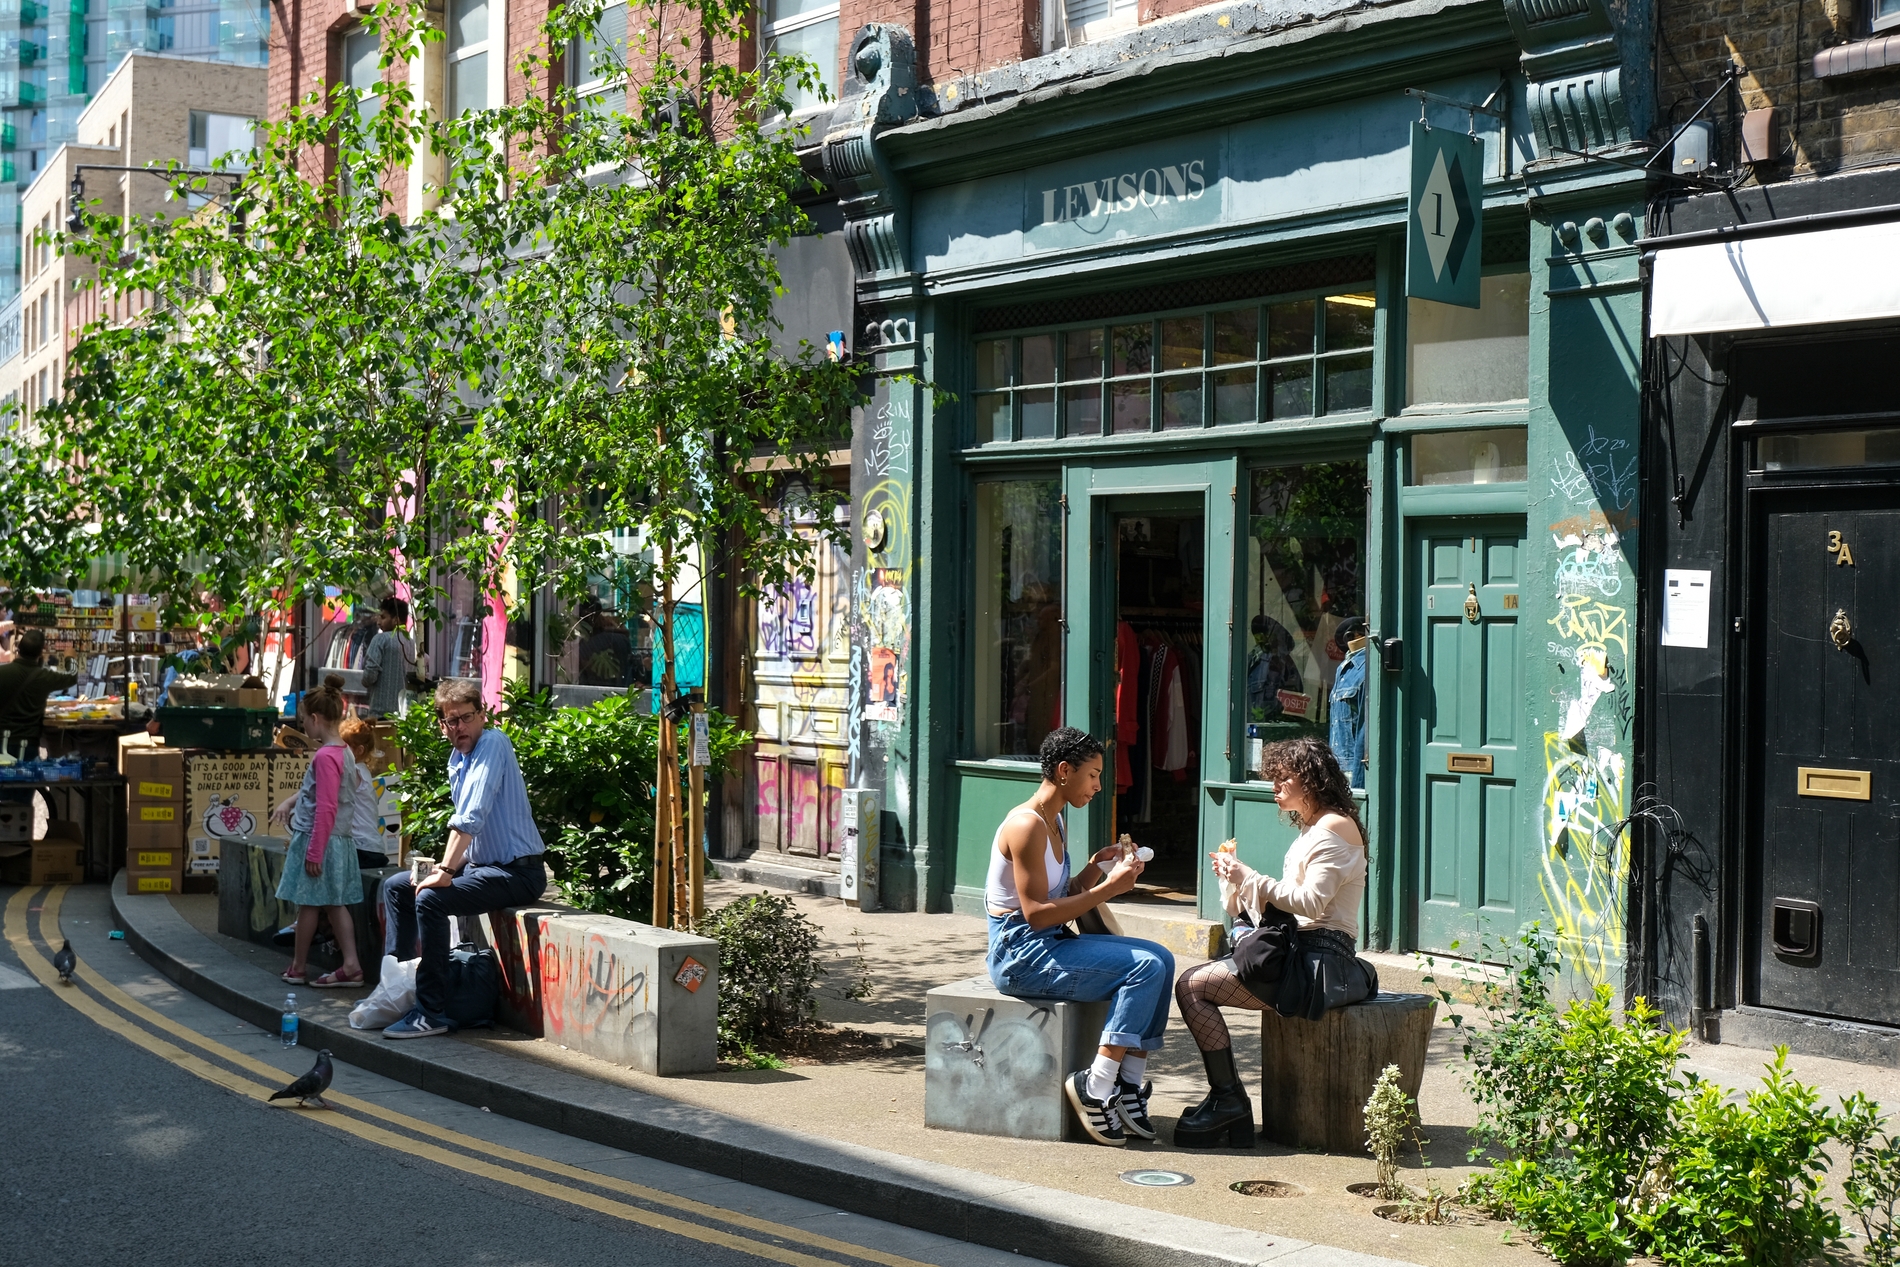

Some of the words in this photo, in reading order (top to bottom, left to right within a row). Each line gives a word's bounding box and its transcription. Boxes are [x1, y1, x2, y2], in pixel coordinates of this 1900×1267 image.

[1041, 160, 1205, 226] LEVISONS
[1431, 192, 1446, 237] 1
[1505, 595, 1519, 609] 1A
[193, 763, 209, 771] IT'S
[212, 763, 218, 771] A
[222, 762, 245, 771] GOOD
[250, 761, 266, 771] DAY
[276, 762, 292, 770] IT'S
[294, 762, 300, 770] A
[202, 772, 213, 781] TO
[214, 772, 229, 781] GET
[285, 771, 295, 780] TO
[197, 782, 222, 791] DINED
[224, 782, 241, 790] AND
